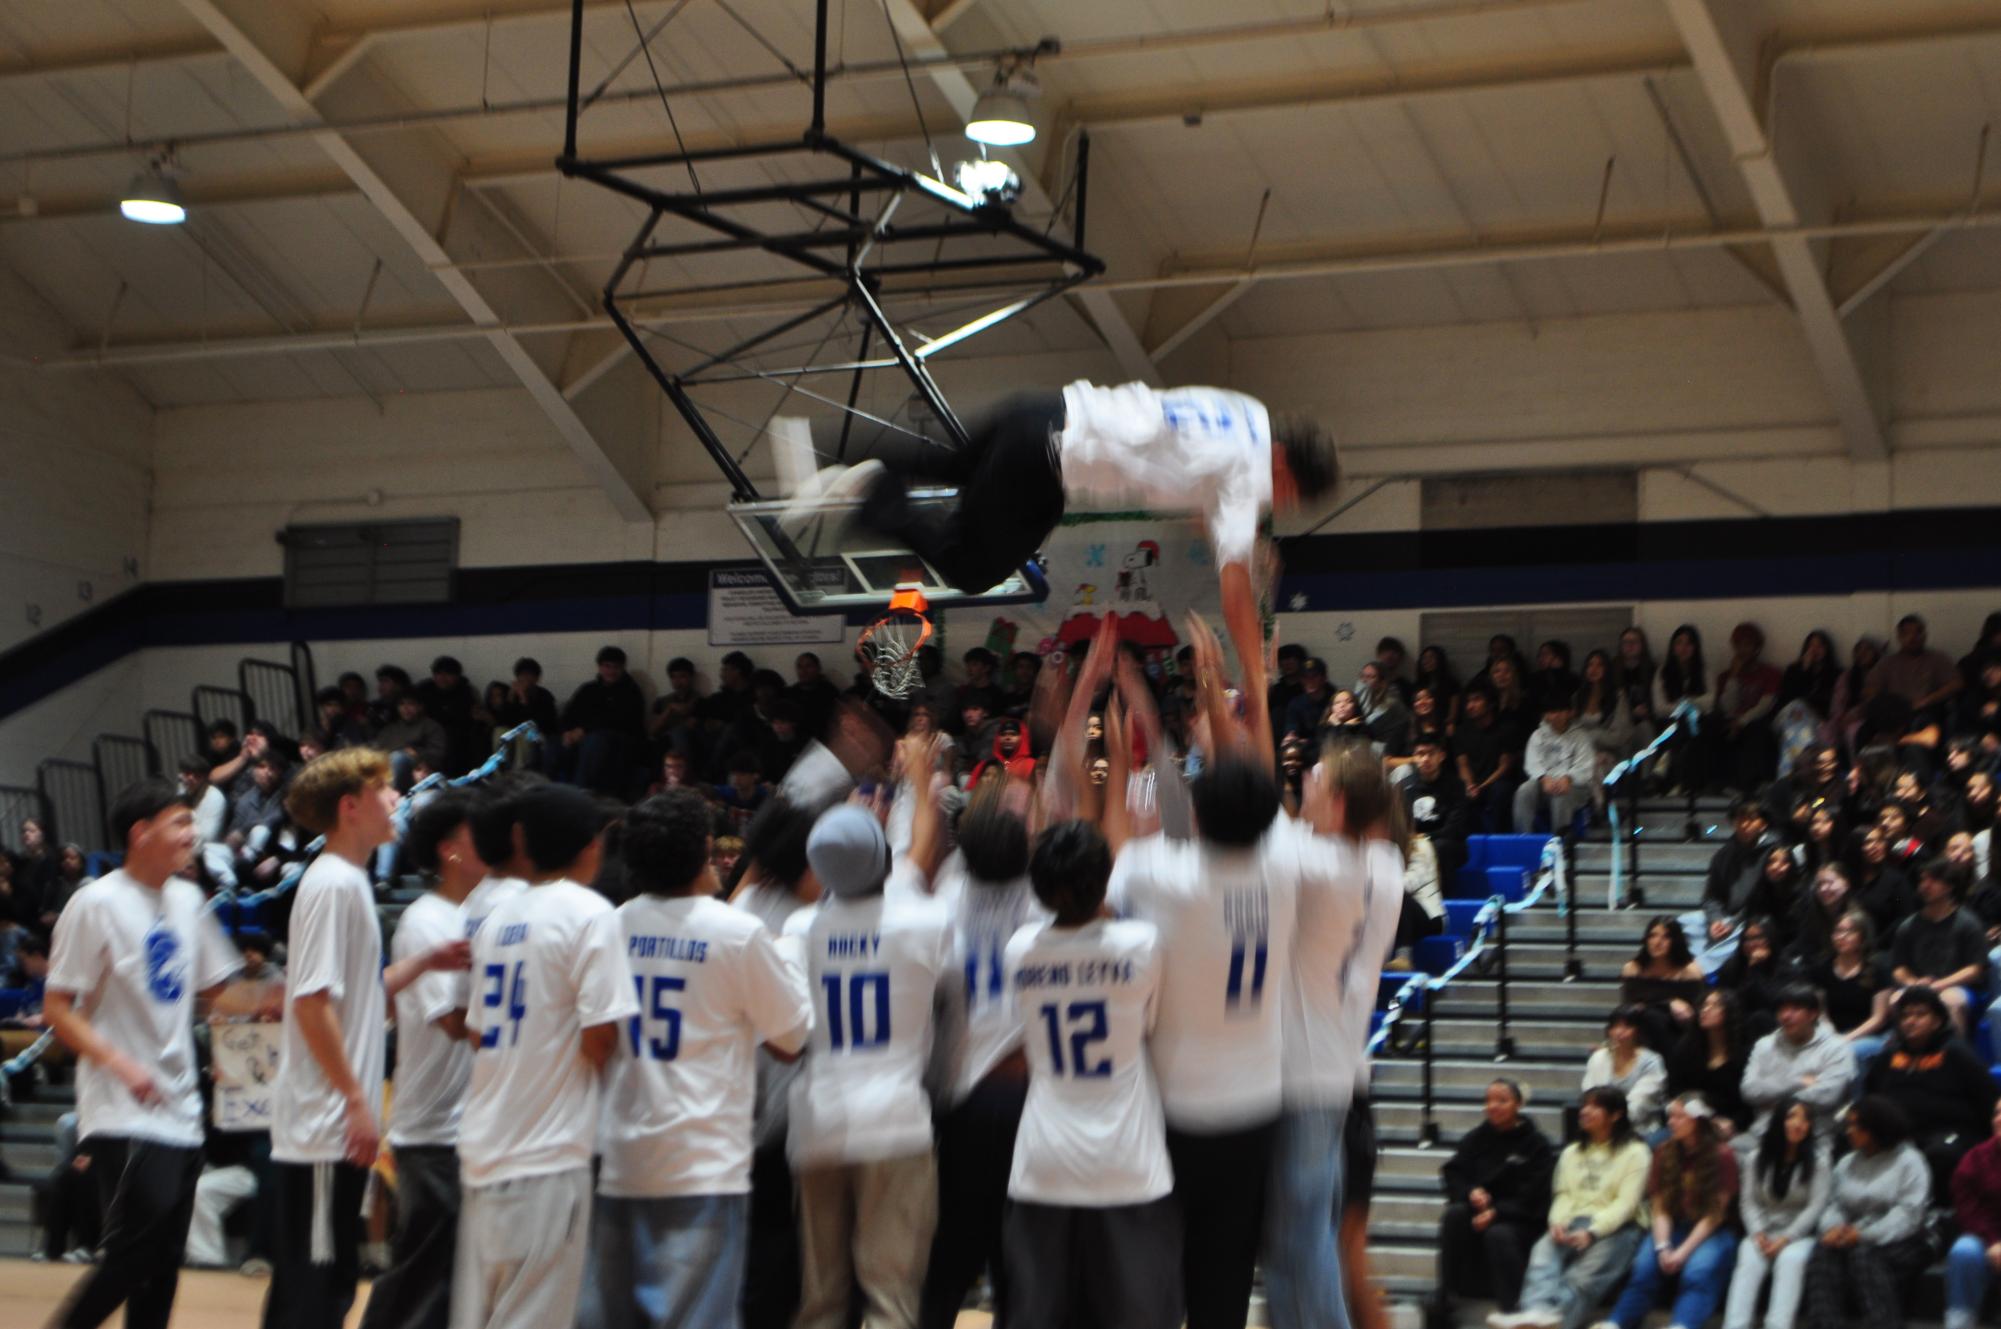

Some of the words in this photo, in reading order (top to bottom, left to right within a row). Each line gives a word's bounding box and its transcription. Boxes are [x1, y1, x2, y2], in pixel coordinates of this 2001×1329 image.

[628, 934, 708, 963] PORTILLOS
[821, 970, 890, 1053] 10
[1039, 997, 1112, 1080] 12
